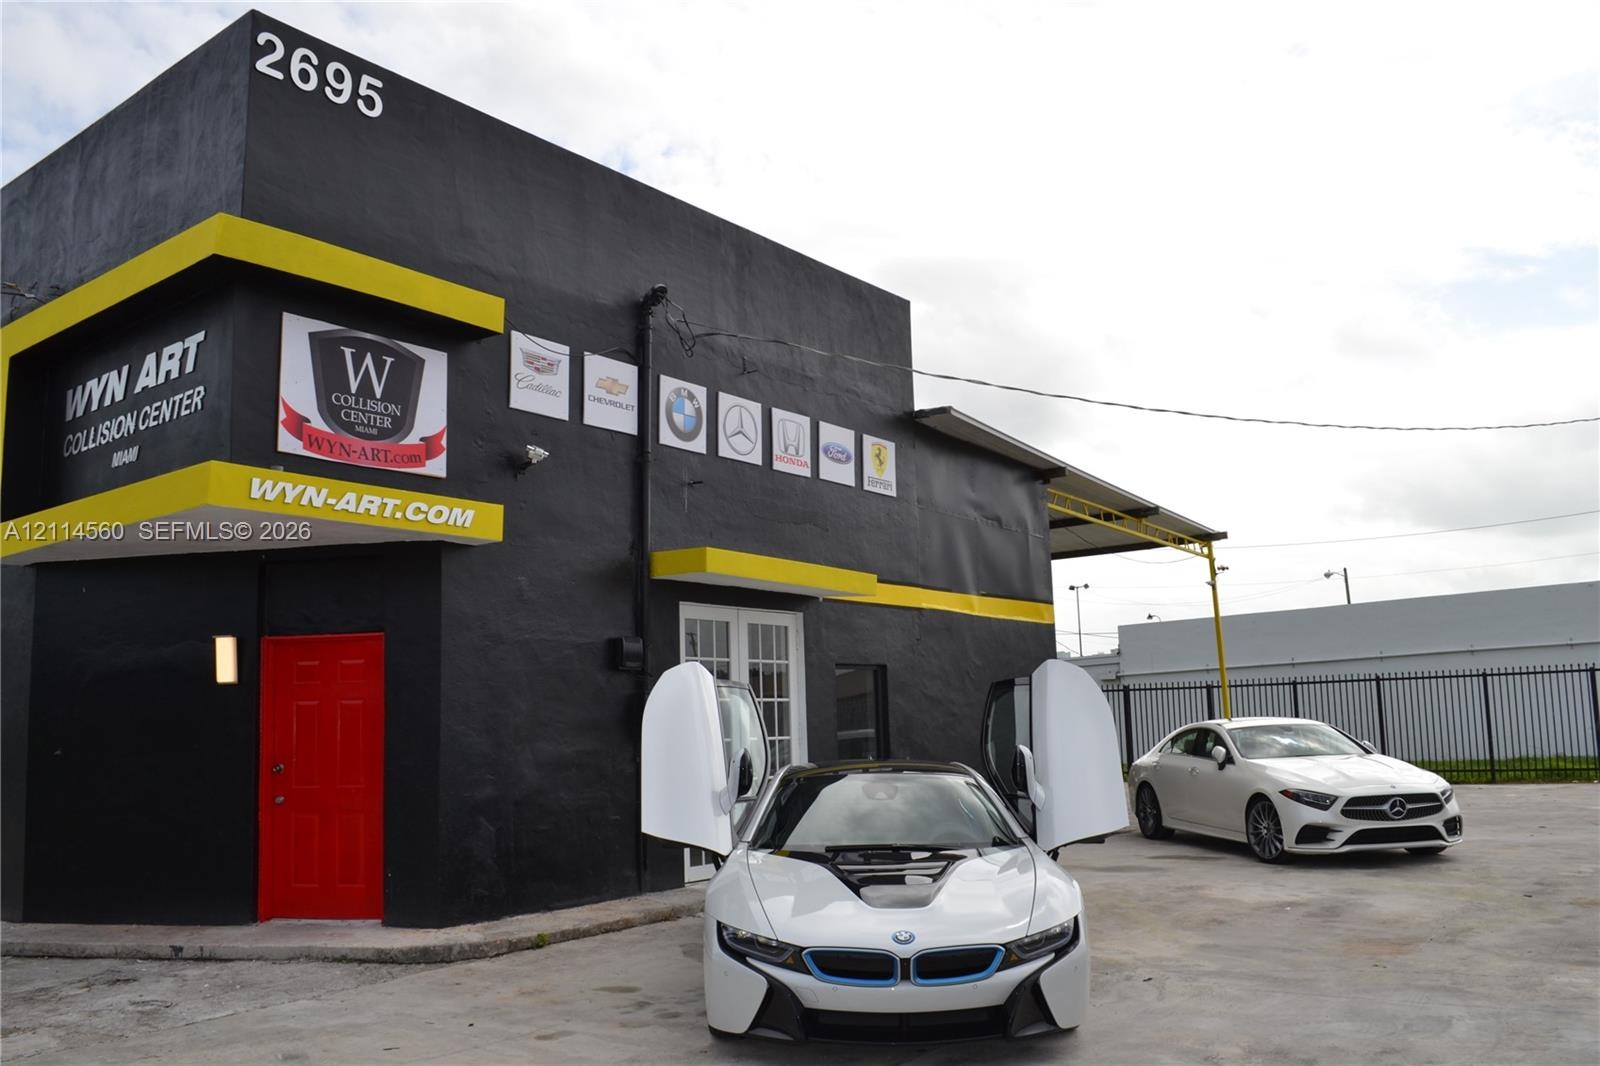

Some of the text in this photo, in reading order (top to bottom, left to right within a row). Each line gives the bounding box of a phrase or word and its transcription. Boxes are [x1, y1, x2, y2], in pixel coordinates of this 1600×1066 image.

[255, 31, 384, 118] 2695
[65, 329, 206, 422] WYN ART
[340, 346, 395, 399] W
[514, 372, 562, 399] Cadillac
[331, 392, 401, 417] COLLISION
[588, 394, 635, 413] CHEVROLET
[63, 385, 206, 457] COLLISION CENTER
[340, 408, 393, 429] CENTER
[355, 425, 378, 436] MIAMI
[111, 445, 141, 468] MIAMI
[307, 433, 422, 464] WYN-ART.com
[827, 448, 848, 462] Ford
[774, 454, 810, 469] HONDA
[867, 475, 893, 492] Ferrari
[249, 477, 476, 529] WYN-ART.COM
